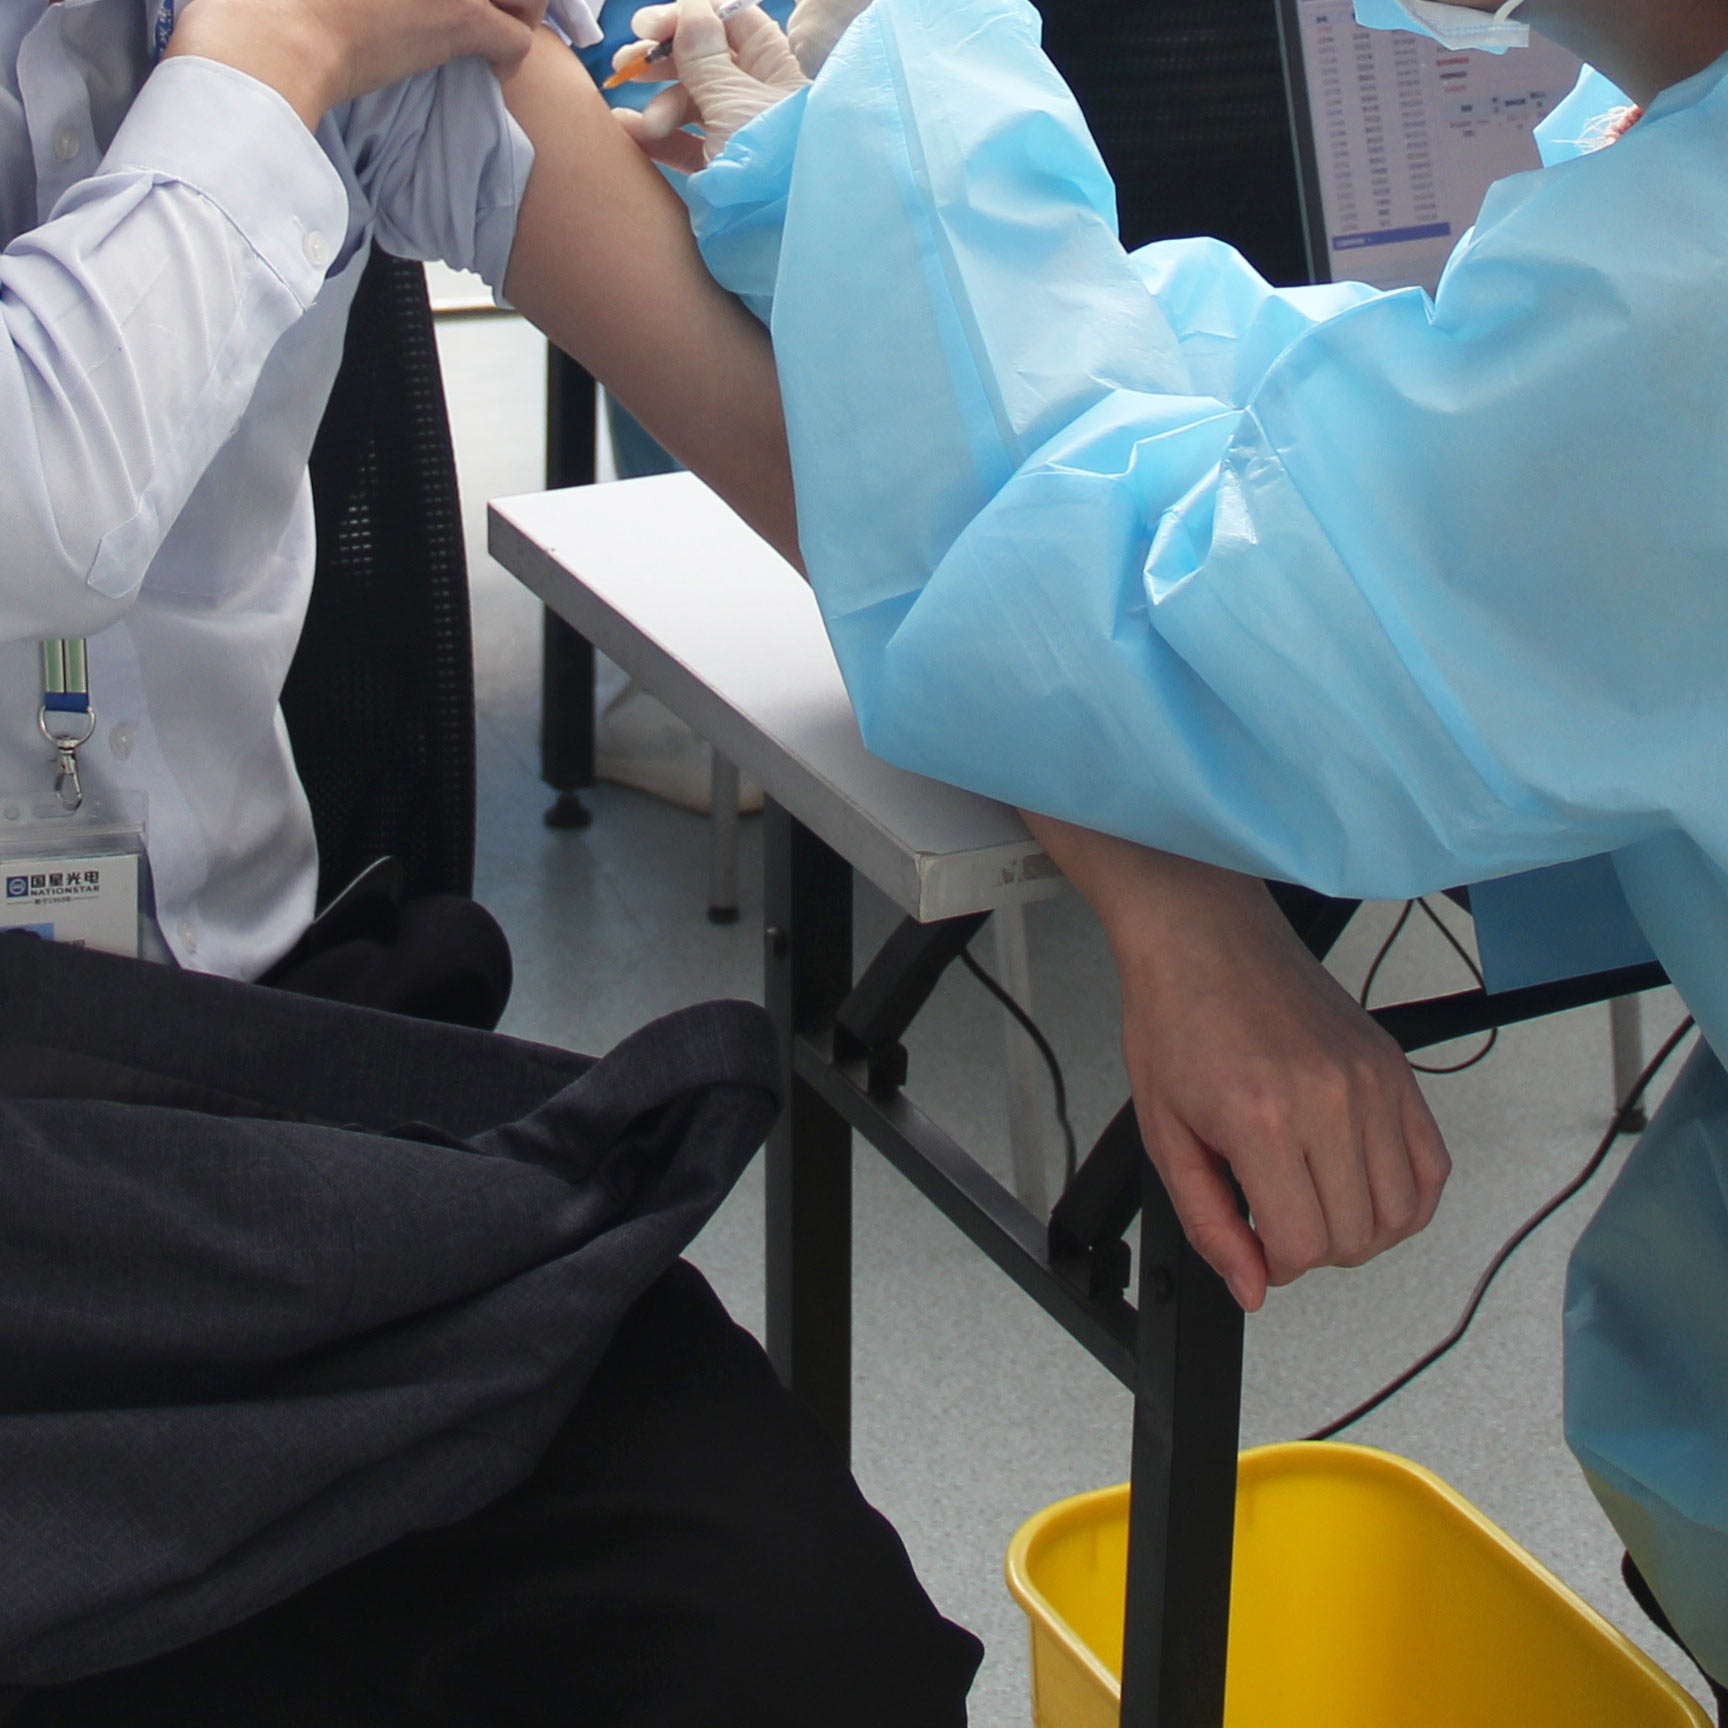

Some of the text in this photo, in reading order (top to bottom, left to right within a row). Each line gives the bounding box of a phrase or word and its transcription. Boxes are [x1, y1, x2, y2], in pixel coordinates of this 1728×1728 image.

[31, 871, 100, 889] 国星光电
[30, 884, 100, 897] NATIONSTAR
